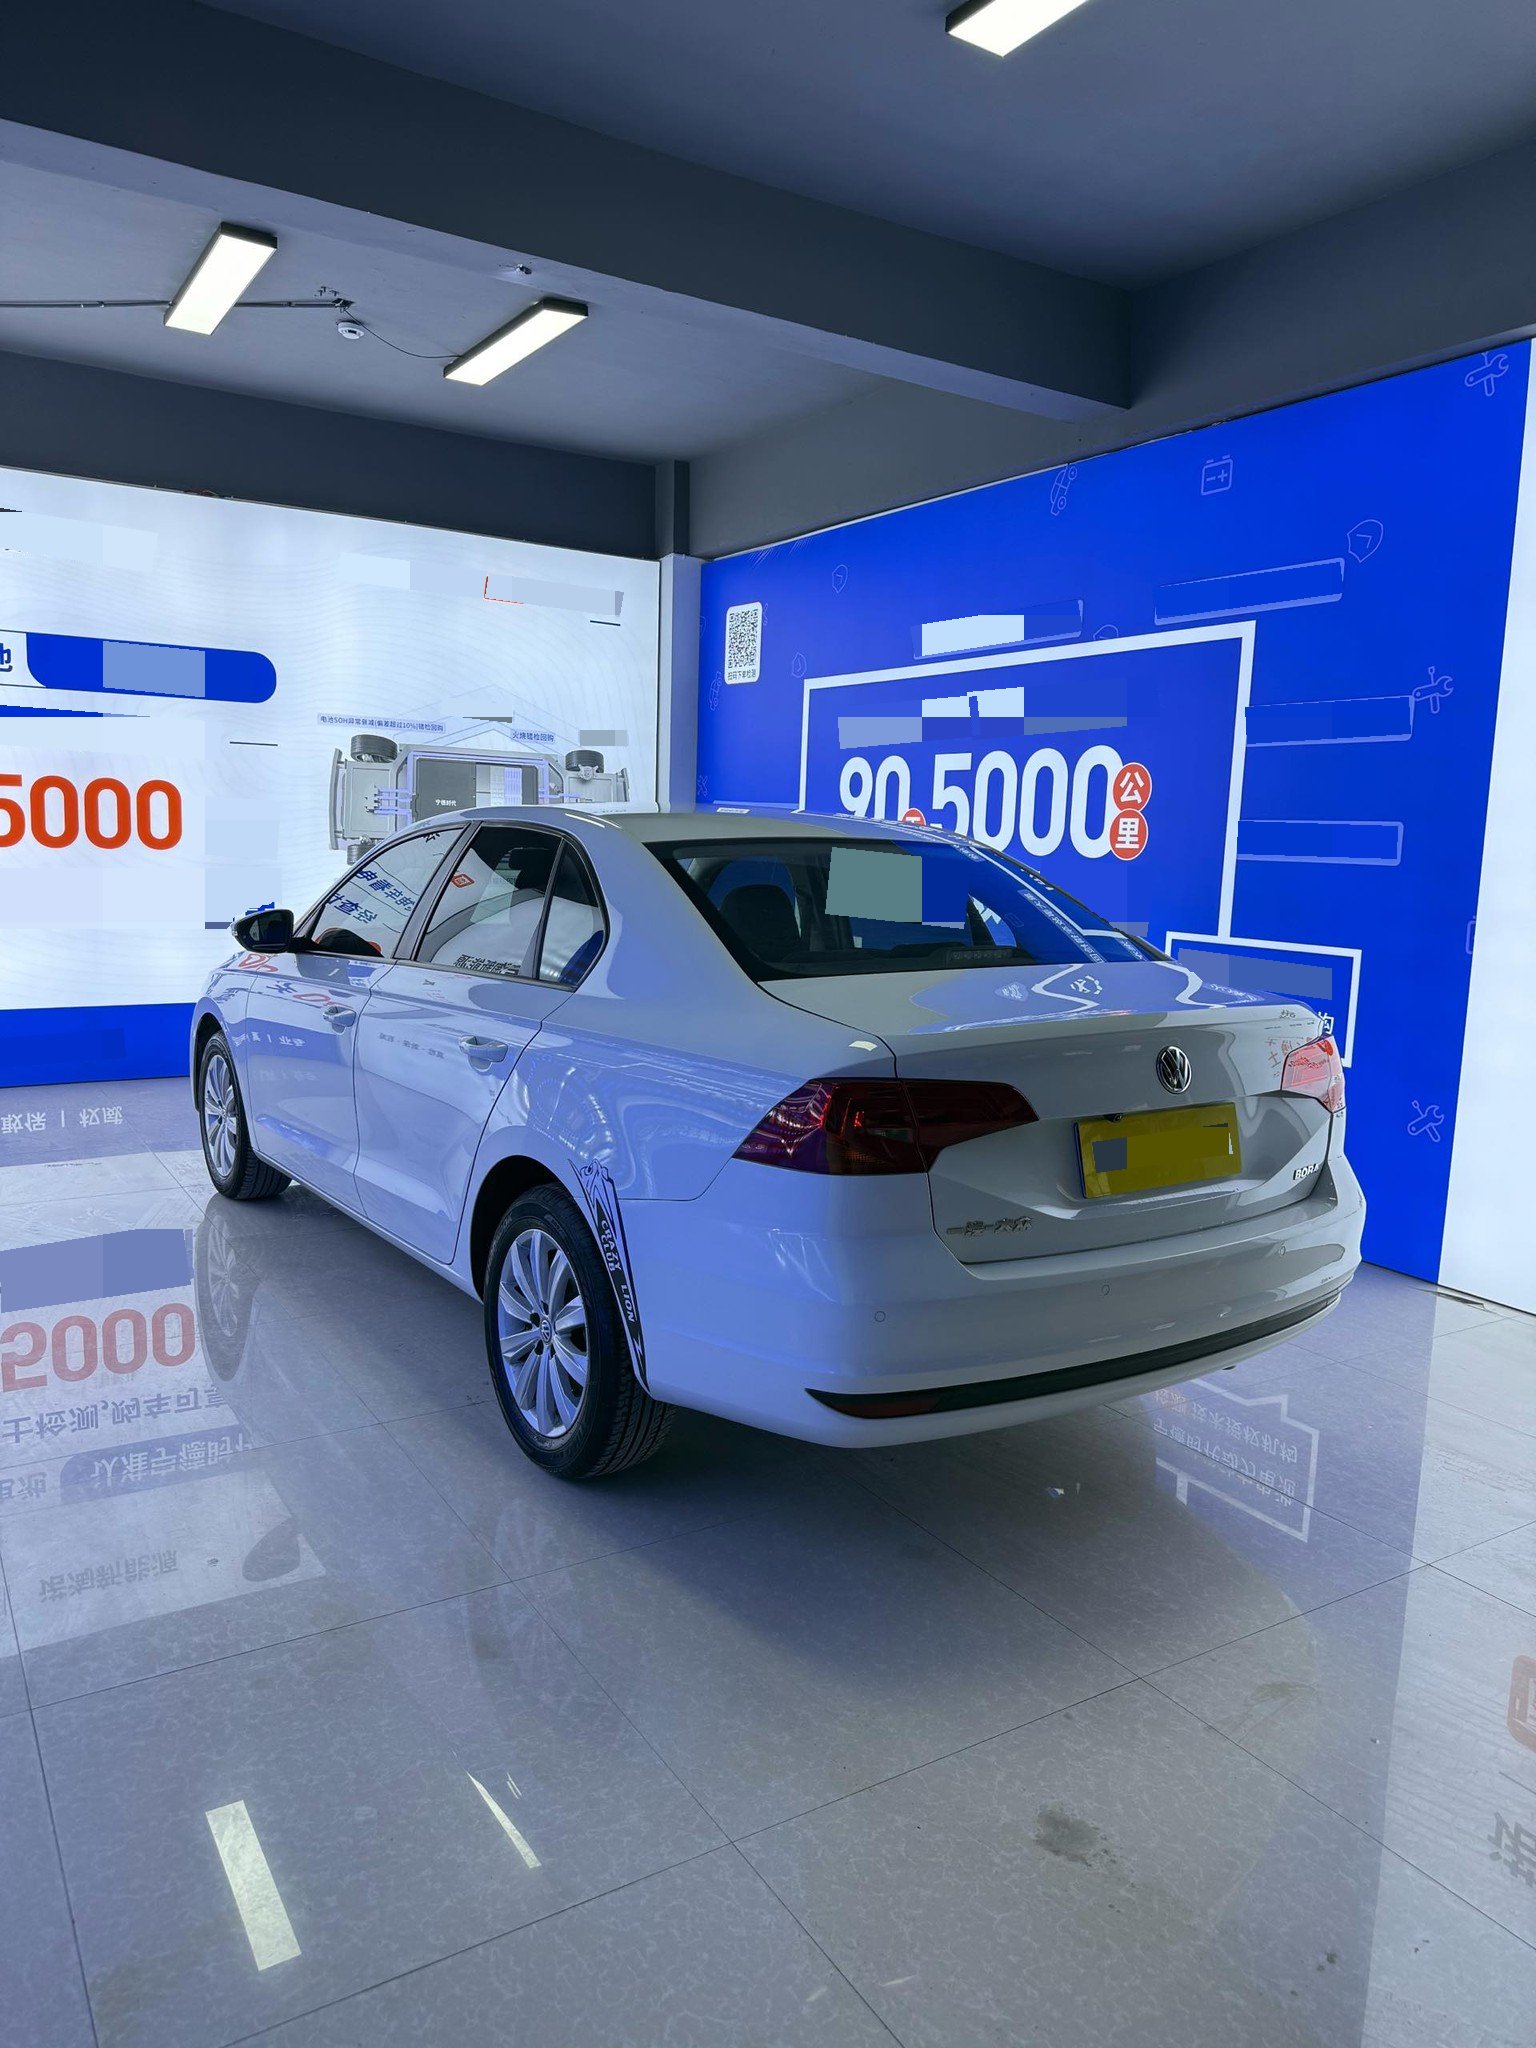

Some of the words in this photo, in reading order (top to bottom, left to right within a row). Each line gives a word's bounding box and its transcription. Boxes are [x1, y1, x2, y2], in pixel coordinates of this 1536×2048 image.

[839, 755, 911, 820] 90
[932, 745, 1123, 858] 5000
[1114, 771, 1146, 849] 公里
[1293, 1163, 1320, 1180] BORA
[601, 1220, 621, 1271] CRAZY
[621, 1284, 636, 1322] LION
